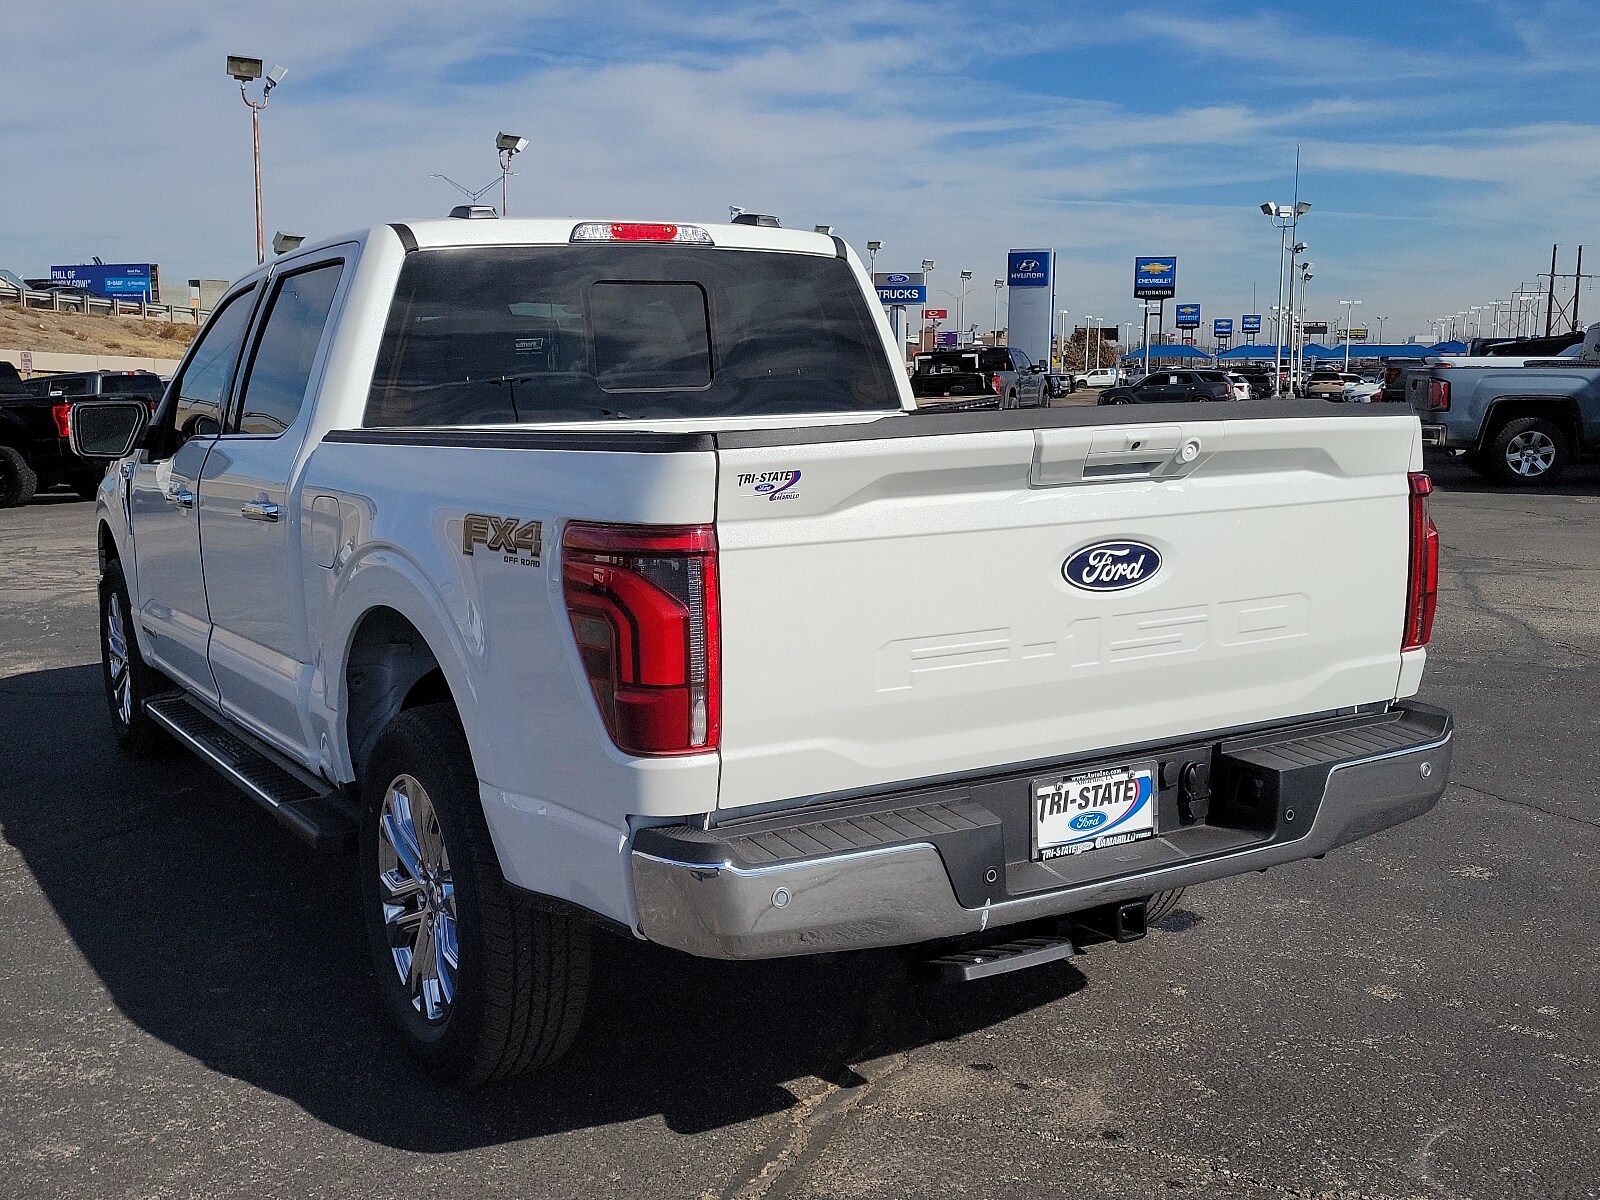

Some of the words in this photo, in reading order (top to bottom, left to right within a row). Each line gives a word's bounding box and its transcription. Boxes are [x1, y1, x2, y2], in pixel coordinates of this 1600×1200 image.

[52, 270, 67, 279] FULL
[67, 270, 76, 279] OF
[877, 289, 919, 299] TRUCKS
[736, 470, 793, 487] TRI-STATE
[463, 514, 542, 557] FX4
[503, 556, 518, 564] OFF
[520, 558, 540, 568] ROAD
[876, 592, 1311, 693] F-150
[1037, 779, 1135, 824] TRI-STATE
[1041, 843, 1081, 861] TRI-STATE
